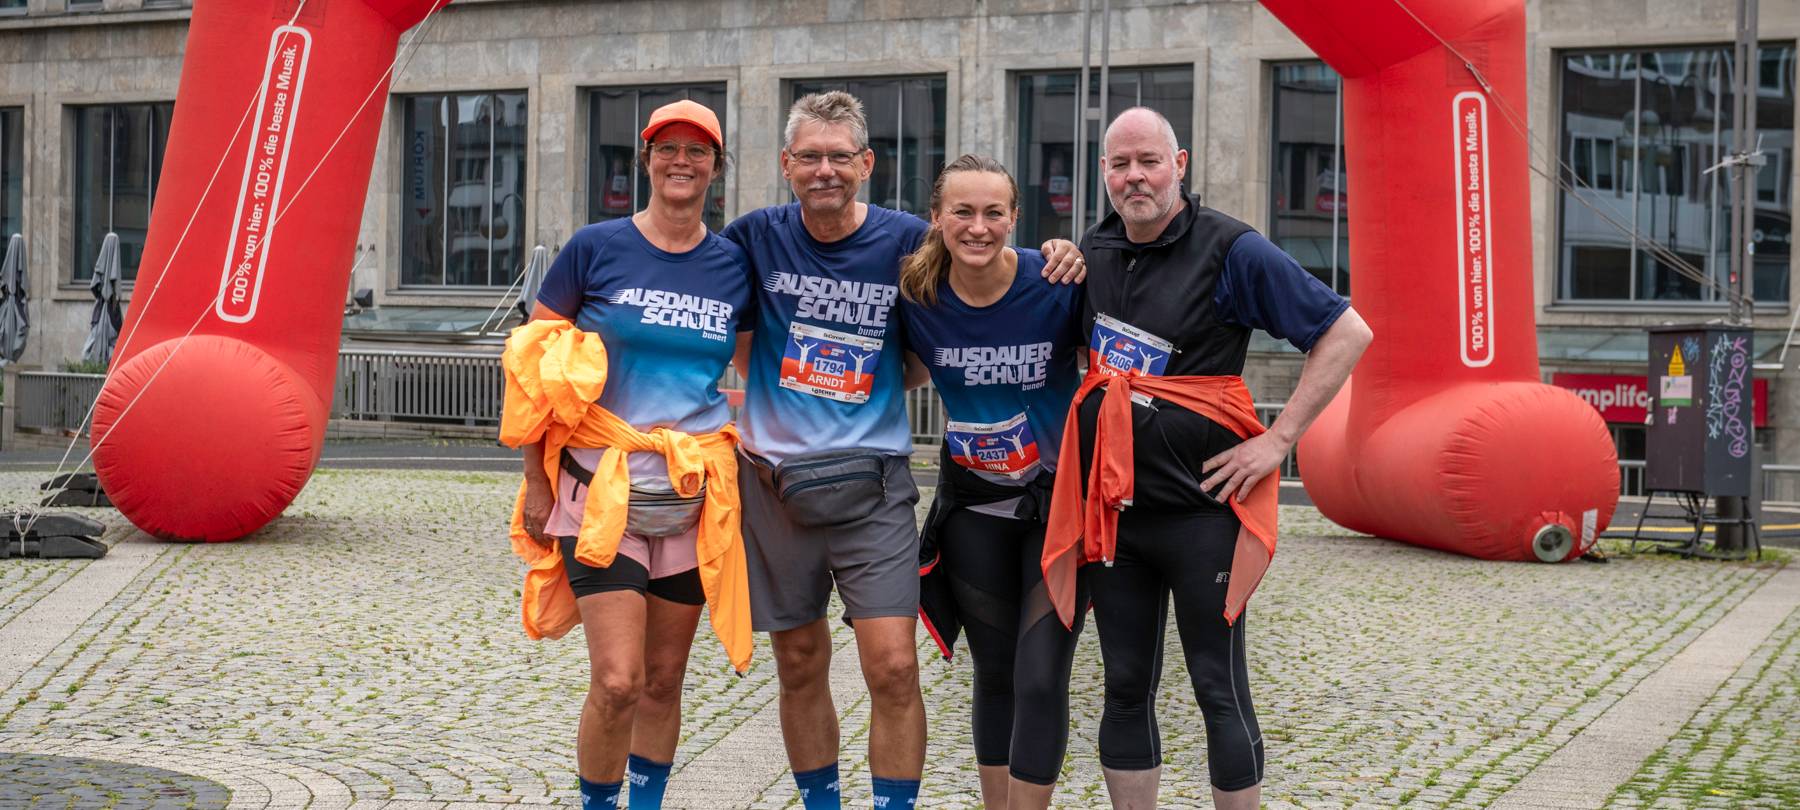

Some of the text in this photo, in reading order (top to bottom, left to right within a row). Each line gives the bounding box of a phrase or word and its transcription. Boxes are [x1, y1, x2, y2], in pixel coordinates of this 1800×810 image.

[231, 44, 298, 305] 100% von hier. 100% die beste Musik.
[1465, 108, 1484, 352] 100% von hier. 100% die beste Musik.
[769, 271, 899, 307] AUSDAUER
[614, 288, 733, 319] AUSDAUER
[795, 296, 890, 327] SCHULE
[640, 307, 728, 334] SCHULE
[857, 326, 886, 337] bunert
[702, 331, 727, 342] bunert
[937, 341, 1053, 368] AUSDAUER
[1106, 352, 1132, 372] 2406
[815, 359, 844, 375] 1794
[964, 361, 1047, 386] SCHULE
[807, 374, 846, 388] ARNDT
[1022, 380, 1046, 391] bunert
[978, 449, 1006, 461] 2437
[984, 462, 1010, 471] NINA
